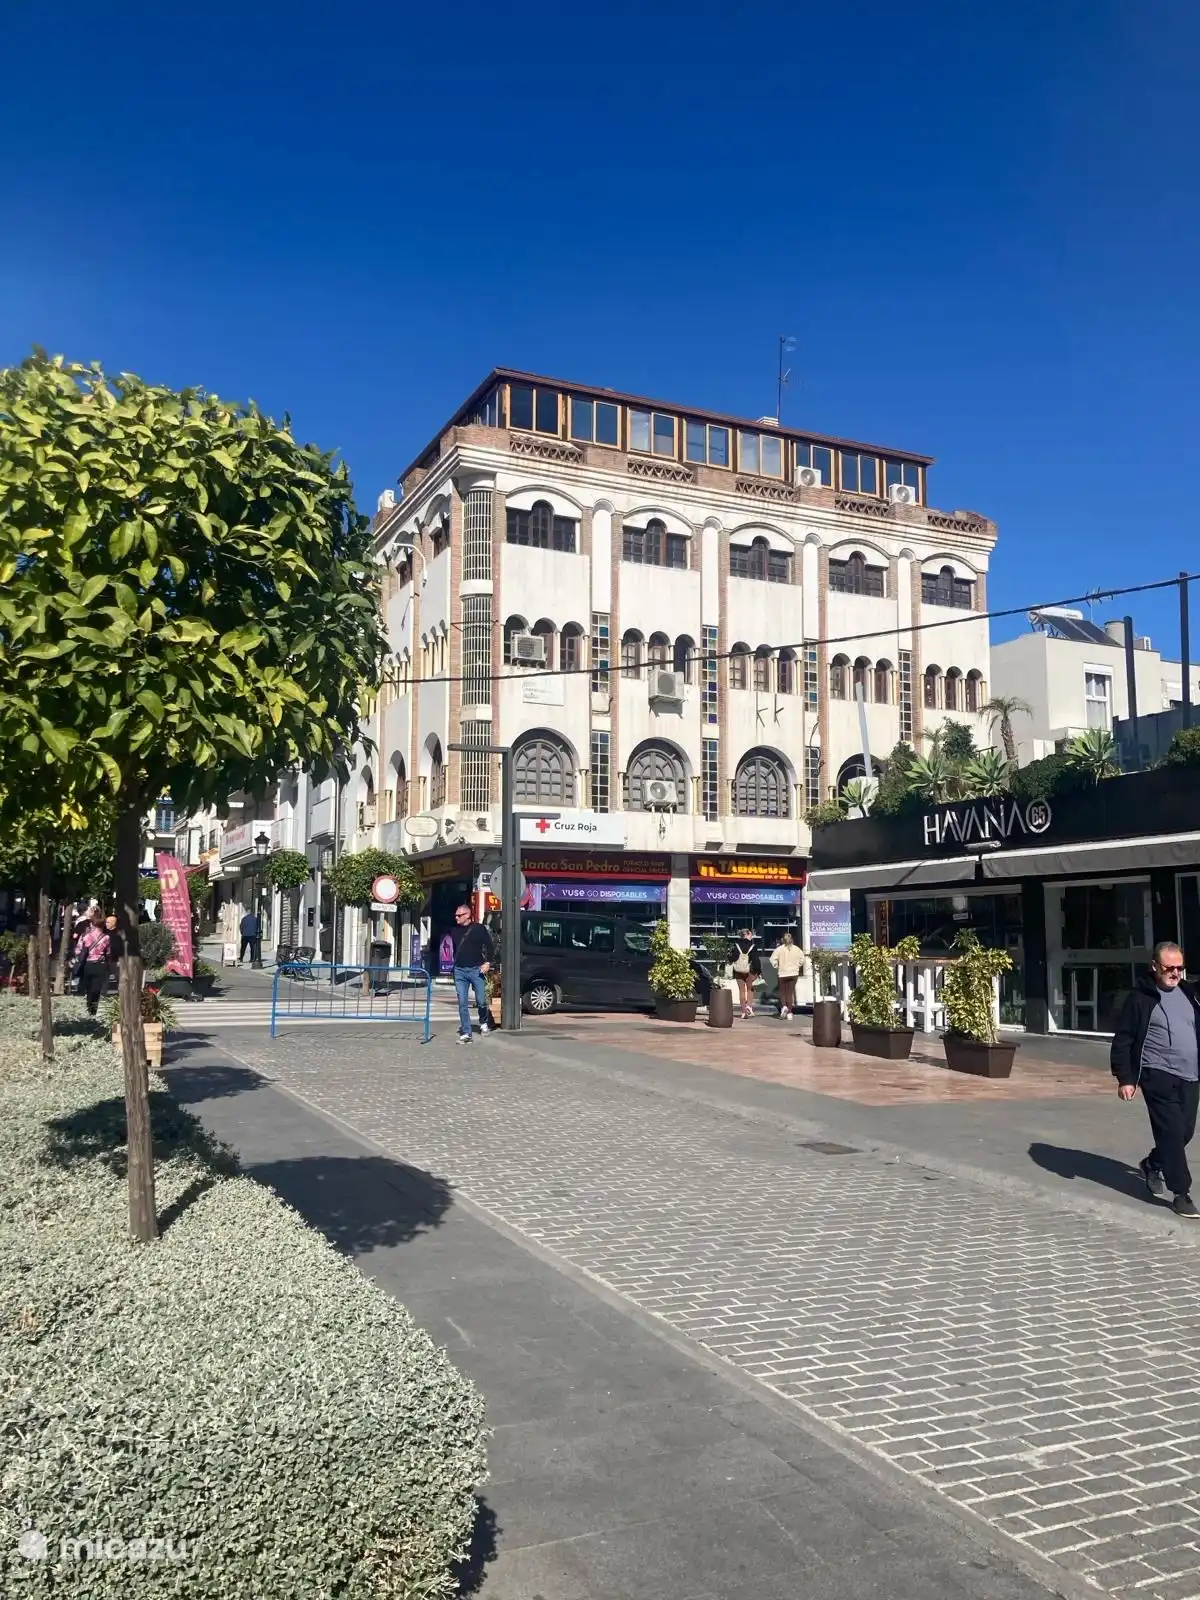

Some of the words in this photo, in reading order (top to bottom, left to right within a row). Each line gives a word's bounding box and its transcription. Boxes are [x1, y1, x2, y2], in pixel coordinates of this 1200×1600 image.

[554, 821, 575, 831] Cruz
[577, 823, 597, 833] Roja
[923, 800, 1029, 846] HAVANA
[560, 859, 583, 871] San
[586, 859, 620, 873] Pedro
[718, 859, 789, 875] TABACOS
[600, 889, 648, 899] DISPOSABLES
[741, 893, 784, 901] DISPOSABLES
